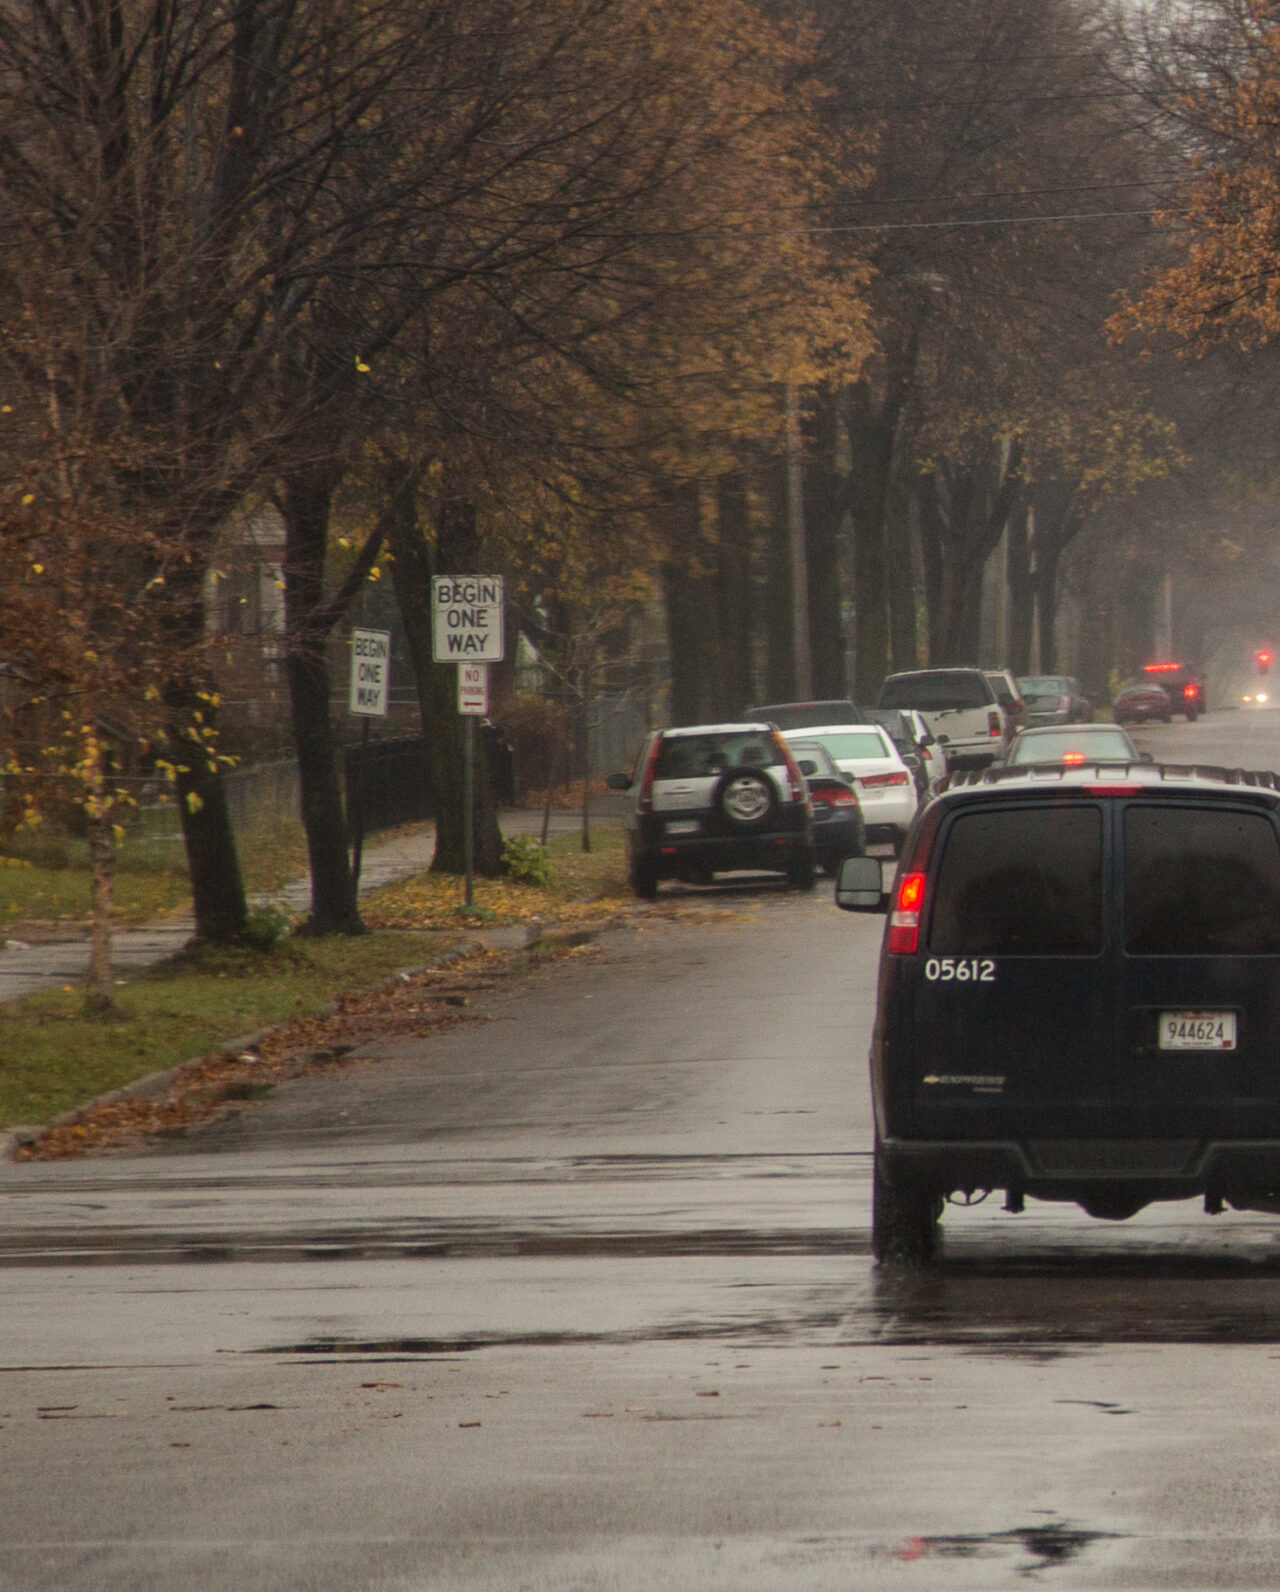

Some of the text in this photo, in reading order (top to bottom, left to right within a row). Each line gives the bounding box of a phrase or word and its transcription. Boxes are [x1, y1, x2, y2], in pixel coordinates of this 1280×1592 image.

[438, 584, 496, 604] BEGIN
[447, 609, 488, 628] ONE
[355, 637, 386, 658] BEGIN
[447, 634, 488, 652] WAY
[358, 663, 381, 684] ONE
[465, 670, 480, 682] NO
[357, 688, 380, 707] WAY
[925, 959, 995, 981] 05612
[1168, 1022, 1224, 1040] 944624
